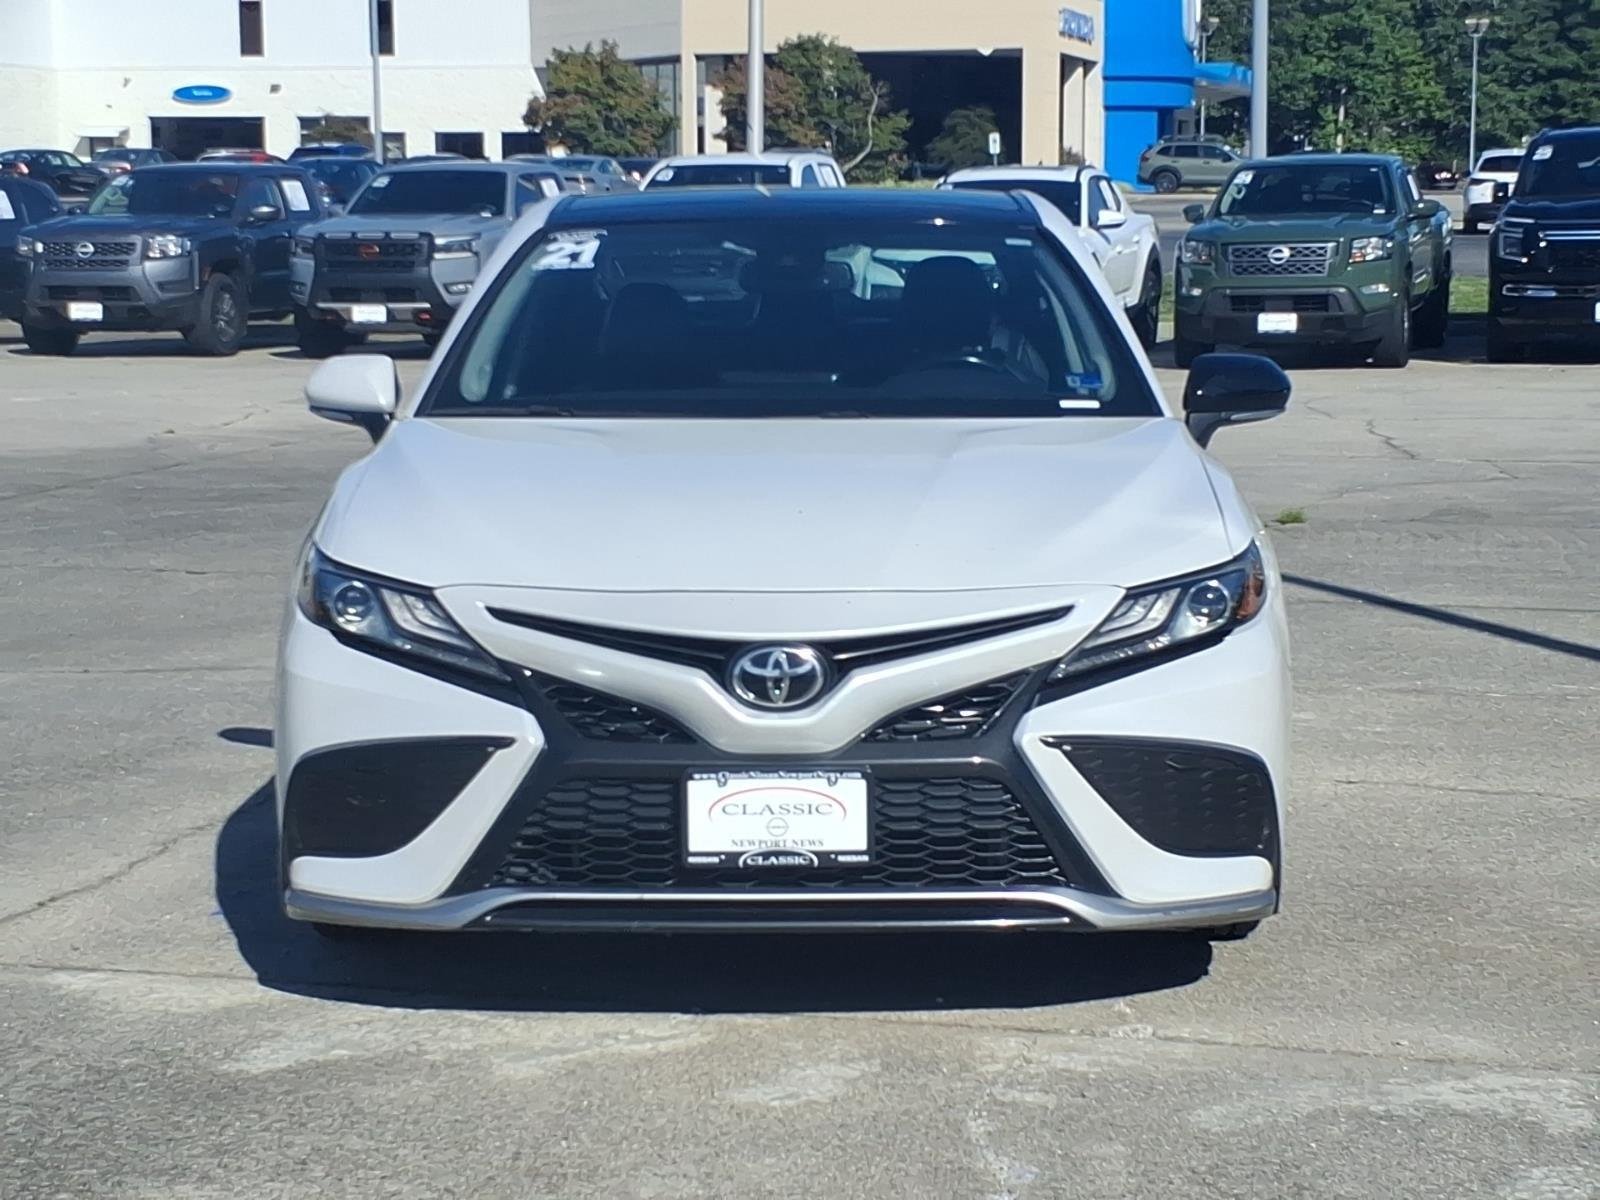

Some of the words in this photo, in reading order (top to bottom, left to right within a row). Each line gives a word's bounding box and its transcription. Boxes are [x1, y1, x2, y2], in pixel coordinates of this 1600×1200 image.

[722, 803, 833, 816] CLASSIC
[731, 839, 787, 848] NEWPORT
[792, 839, 824, 847] NEWS
[746, 855, 811, 866] CLASSIC
